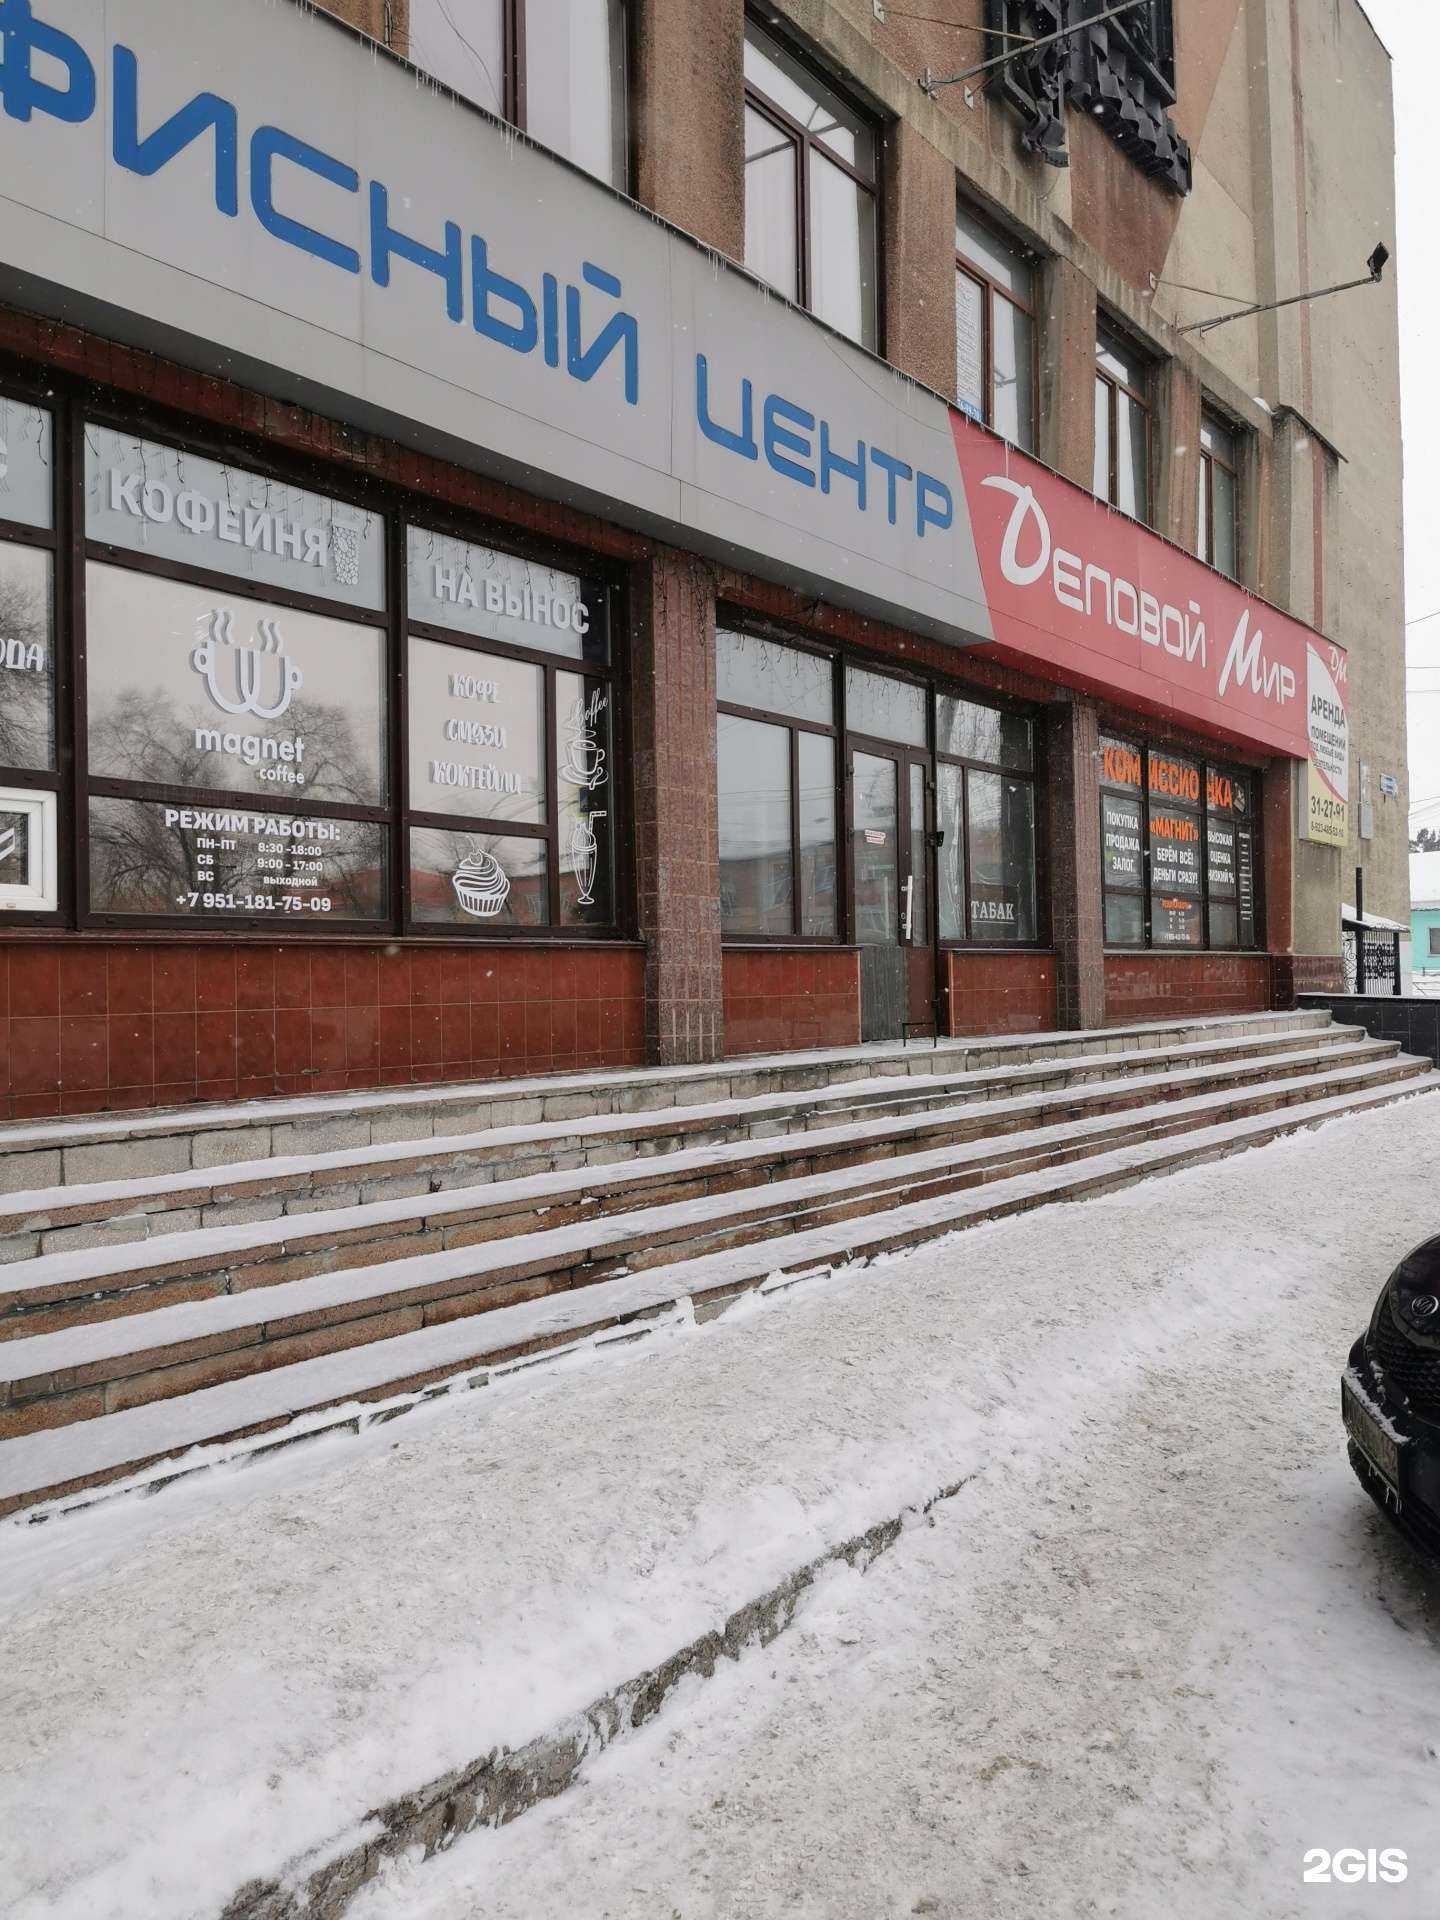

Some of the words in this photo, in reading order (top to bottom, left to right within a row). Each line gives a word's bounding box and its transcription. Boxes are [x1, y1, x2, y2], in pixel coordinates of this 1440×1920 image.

[696, 352, 953, 538] ЦЕНТР
[110, 467, 328, 567] КОФЕЙНЯ
[433, 563, 479, 609] НА
[485, 578, 590, 635] ВЫНОС
[1311, 694, 1346, 729] АРЕНДА
[195, 728, 305, 766] magnet
[259, 764, 305, 785] coffee
[164, 808, 250, 834] РЕЖИМ
[253, 816, 342, 842] РАБОТЫ:
[1106, 811, 1139, 831] ПОКУПКА
[196, 837, 237, 851] ПН-ПТ
[258, 842, 284, 854] 8:30
[1105, 832, 1140, 852] ПРОДАЖА
[1207, 830, 1233, 847] ВЫСОКАЯ
[197, 854, 214, 866] СБ
[257, 858, 283, 870] 9:00
[293, 860, 323, 872] 17:00
[1112, 856, 1135, 872] ЗАЛОГ
[1156, 845, 1178, 864] БЕРЁМ
[1210, 849, 1231, 866] ОЦЕНКА
[197, 871, 215, 882] ВС
[263, 875, 318, 887] выходной
[1153, 867, 1177, 883] ДЕНЬГИ
[1178, 869, 1198, 885] СРАЗУ!
[176, 892, 200, 909] +7
[202, 893, 332, 912] 951-181-75-09
[970, 900, 1015, 921] ТАБАК
